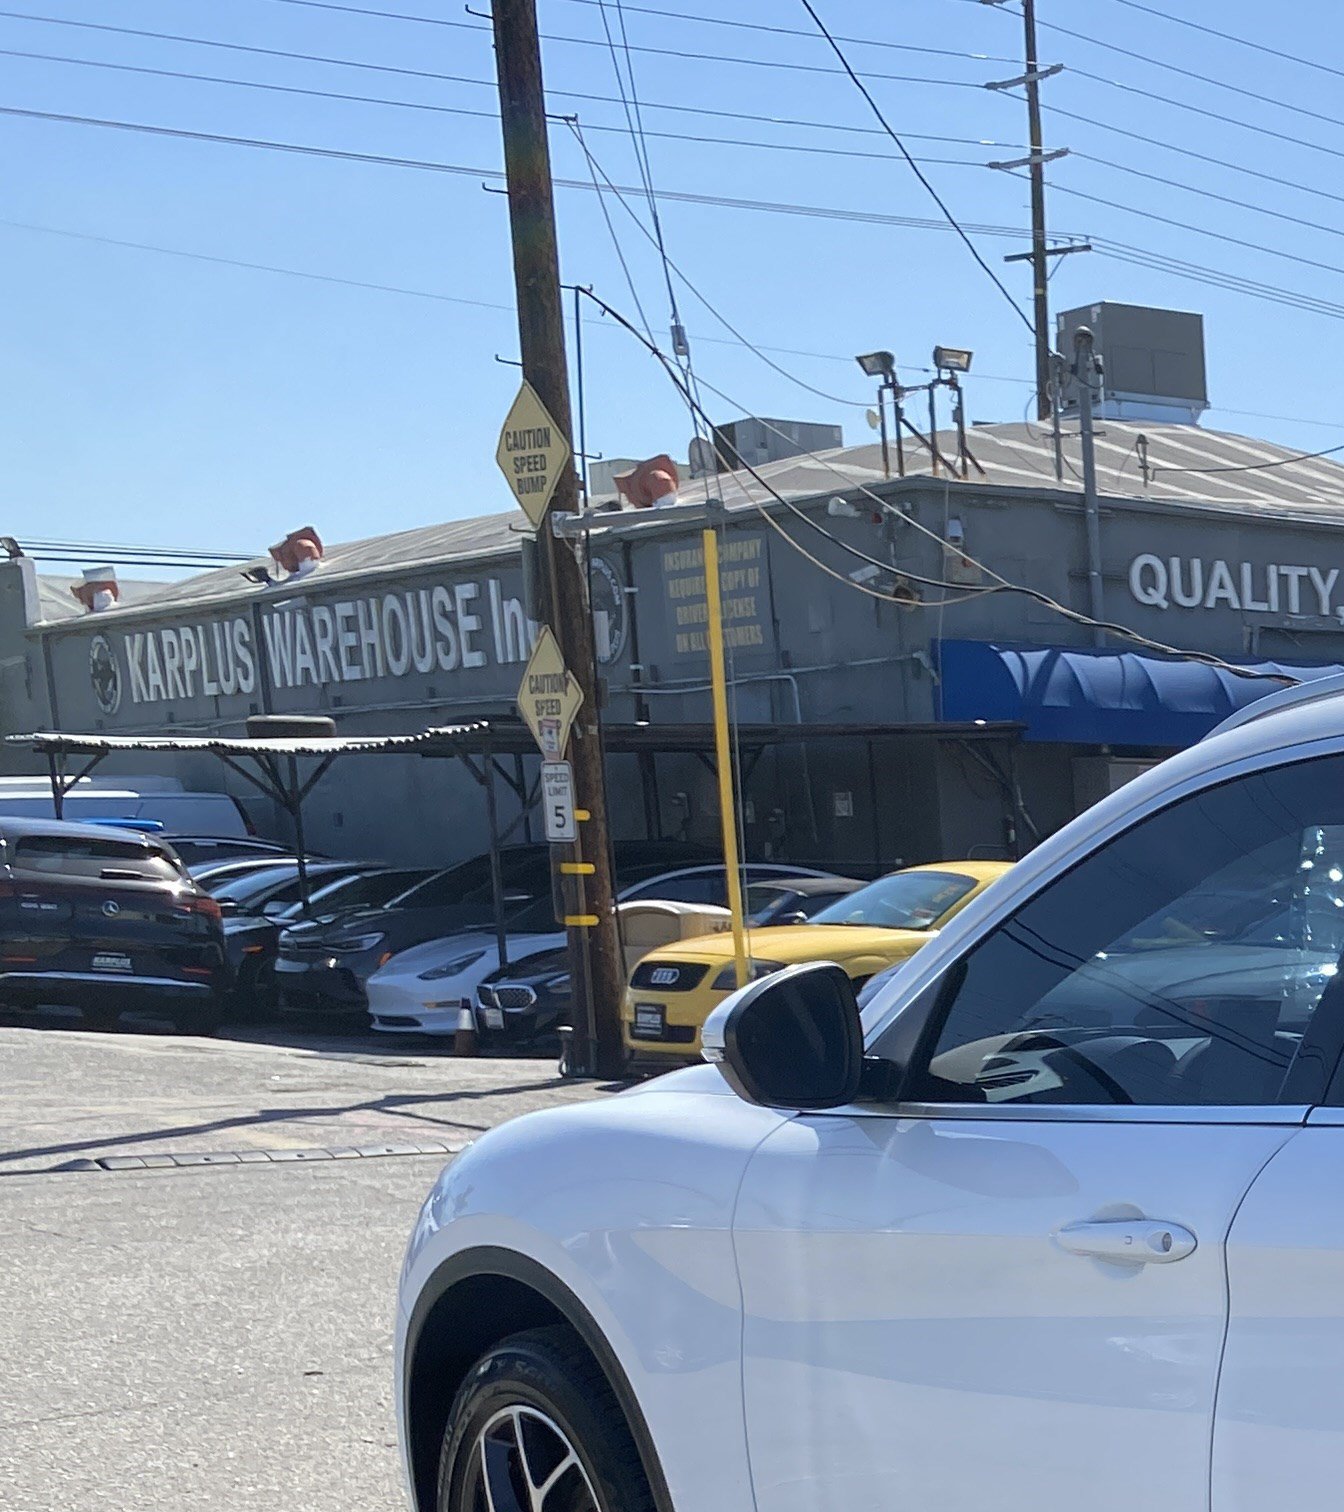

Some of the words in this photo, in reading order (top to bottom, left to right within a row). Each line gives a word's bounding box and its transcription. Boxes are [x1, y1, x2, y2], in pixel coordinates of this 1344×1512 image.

[504, 427, 552, 451] CAUTION
[513, 454, 547, 474] SPEED
[517, 475, 547, 495] BUMP
[124, 618, 255, 703] KARPLUS
[262, 582, 487, 688] WAREHOUSE
[528, 672, 567, 695] CAUTION
[535, 698, 562, 717] SPEED
[544, 772, 569, 784] SPEED
[548, 786, 568, 797] LIMIT
[554, 805, 566, 829] 5
